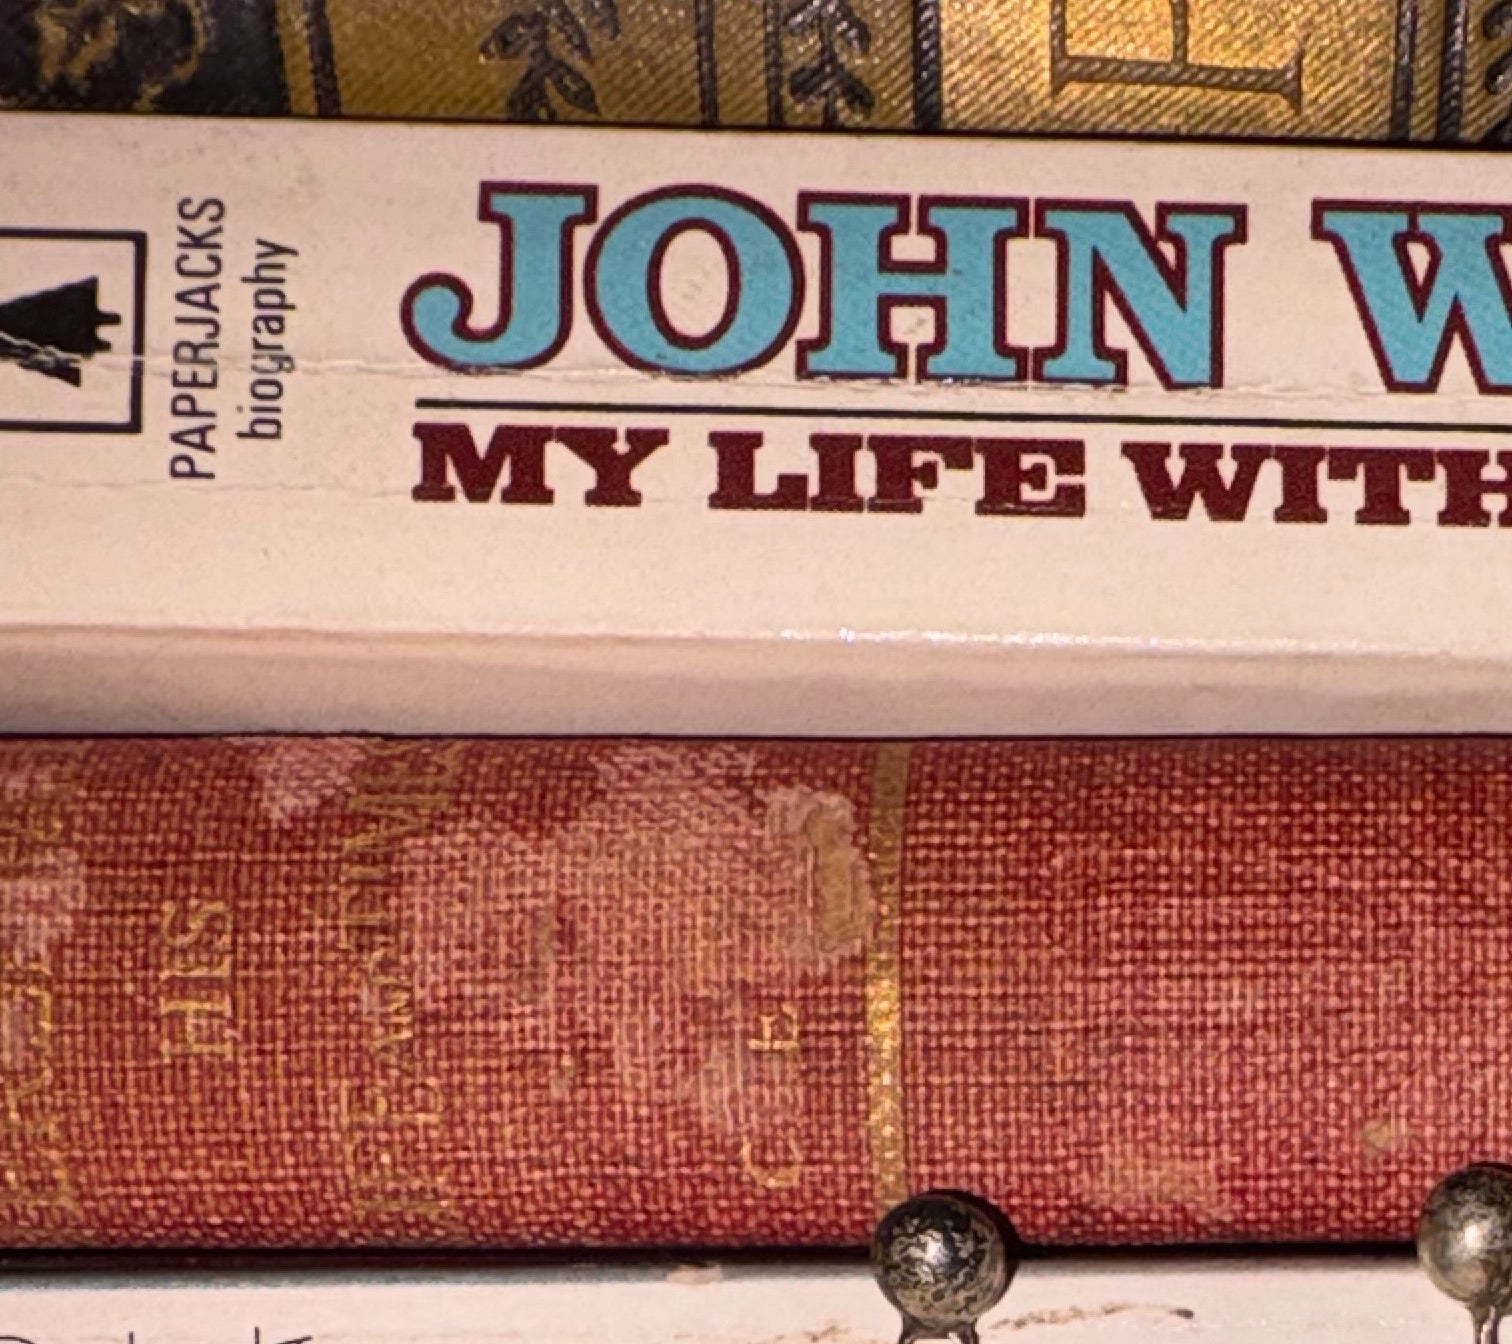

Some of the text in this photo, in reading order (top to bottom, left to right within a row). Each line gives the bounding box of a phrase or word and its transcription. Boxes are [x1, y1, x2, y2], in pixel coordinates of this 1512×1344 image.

[169, 196, 227, 481] PAPERJACKS
[237, 238, 299, 442] biography
[400, 181, 1248, 391] JOHN
[411, 421, 669, 508] MY
[708, 430, 1087, 519] LIFE
[158, 900, 237, 1063] HIS
